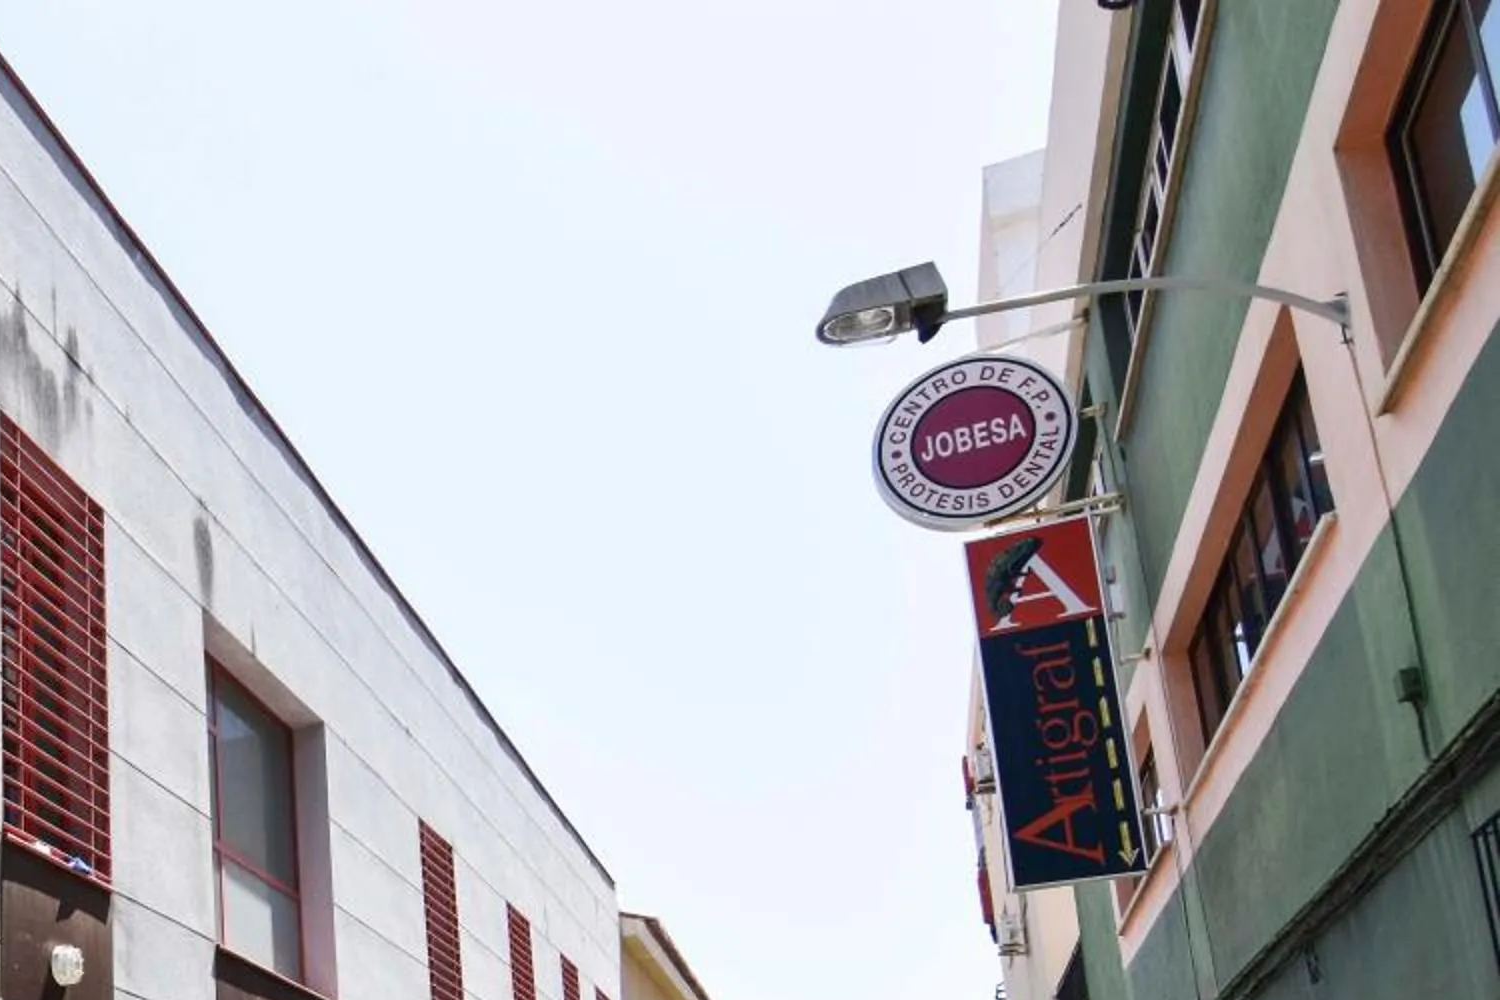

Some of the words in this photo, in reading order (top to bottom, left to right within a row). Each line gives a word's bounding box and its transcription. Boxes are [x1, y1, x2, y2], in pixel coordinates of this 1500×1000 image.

[889, 369, 968, 445] CENTRO
[979, 365, 1015, 384] DE
[920, 413, 1027, 463] JOBESA
[998, 425, 1061, 499] DENTAL
[1012, 640, 1106, 866] Artigraf
